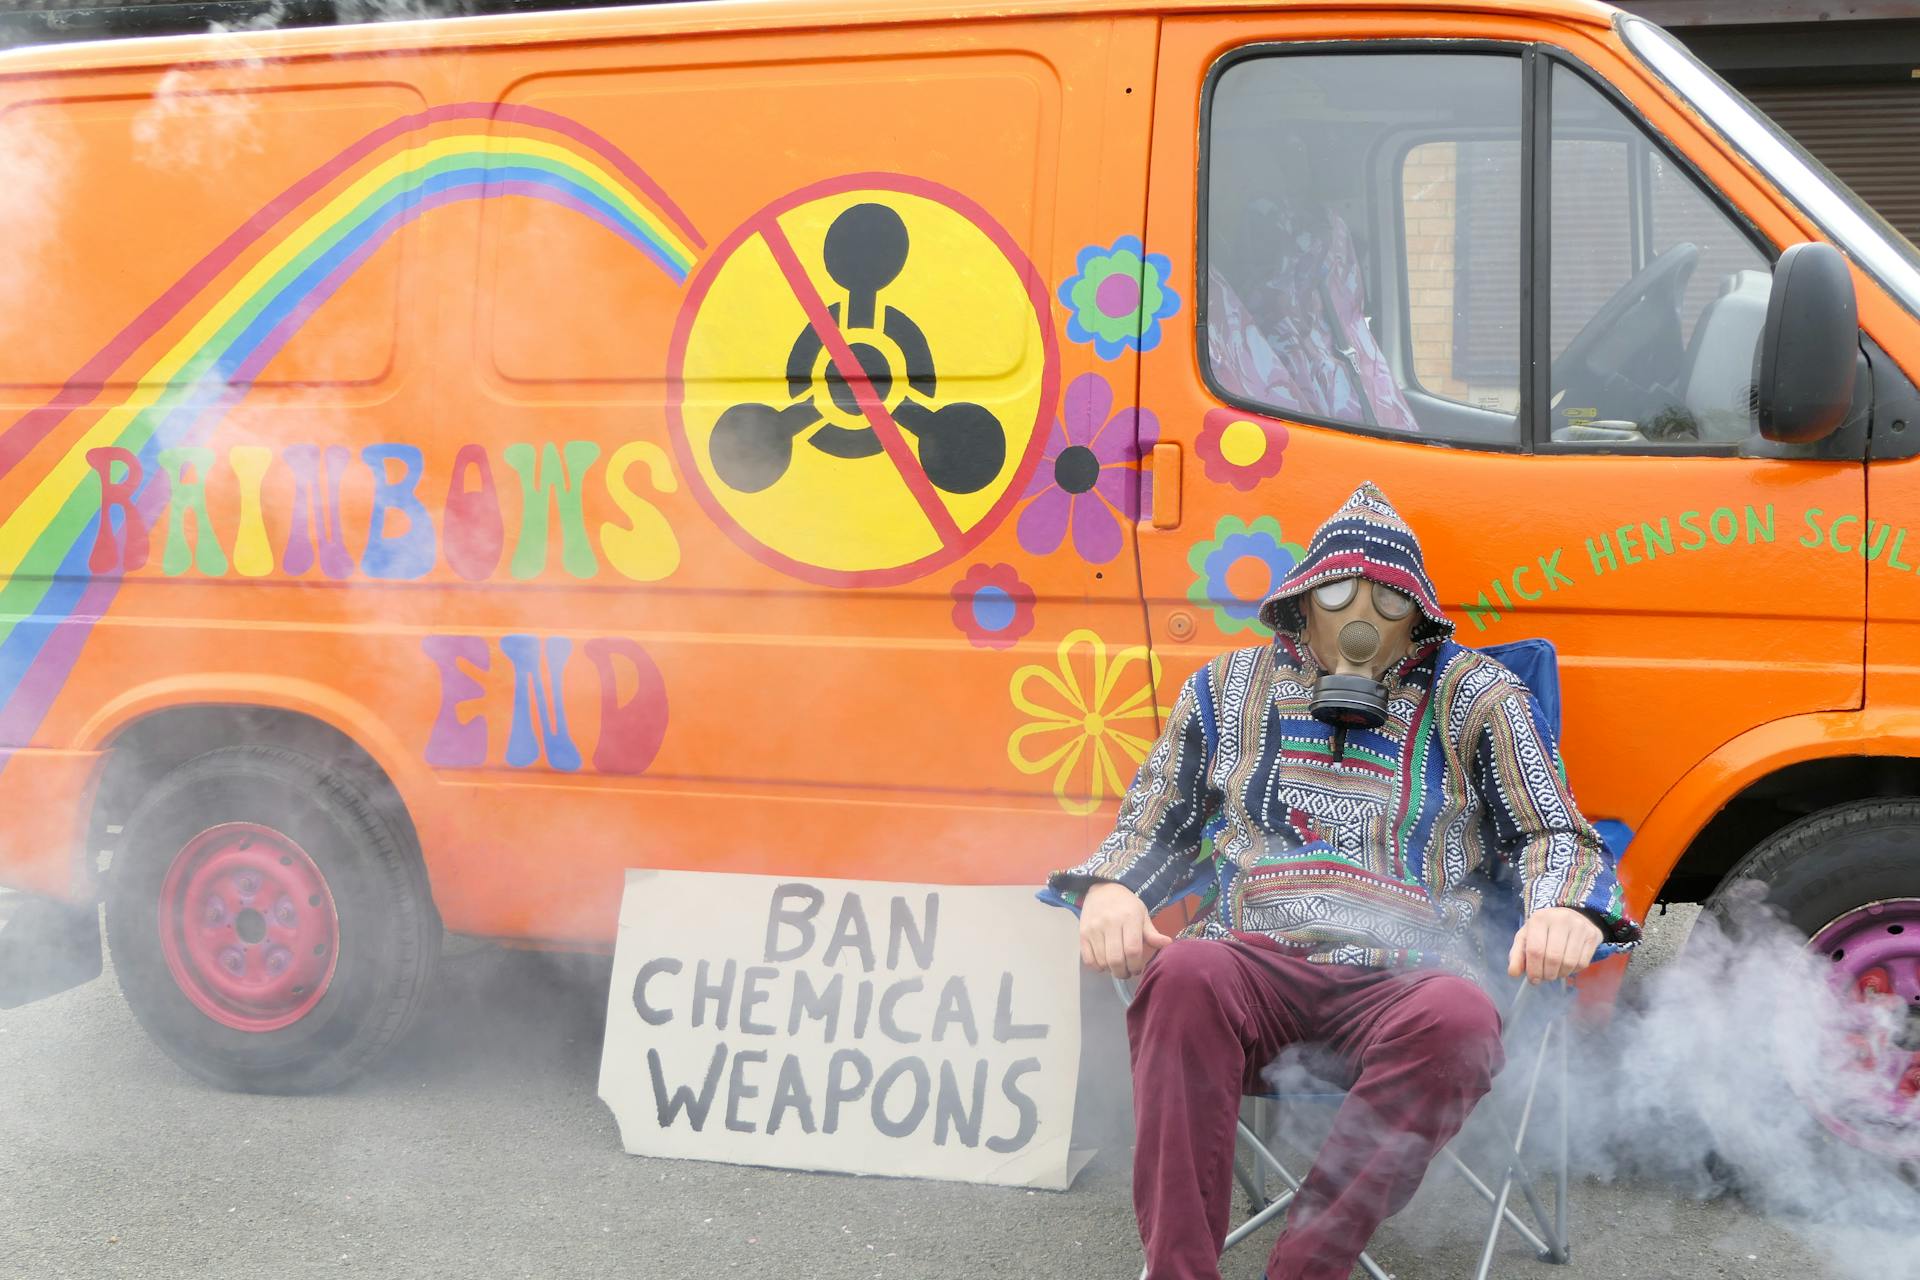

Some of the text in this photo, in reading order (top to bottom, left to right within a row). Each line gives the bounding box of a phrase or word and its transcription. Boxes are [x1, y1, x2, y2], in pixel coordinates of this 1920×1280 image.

[86, 440, 681, 581] RAINBOWS
[1460, 503, 1920, 632] MICK HENSON SCUL
[422, 634, 669, 774] END
[763, 882, 939, 972] BAN
[632, 957, 1050, 1046] CHEMICAL
[647, 1042, 1043, 1154] WEAPONS
